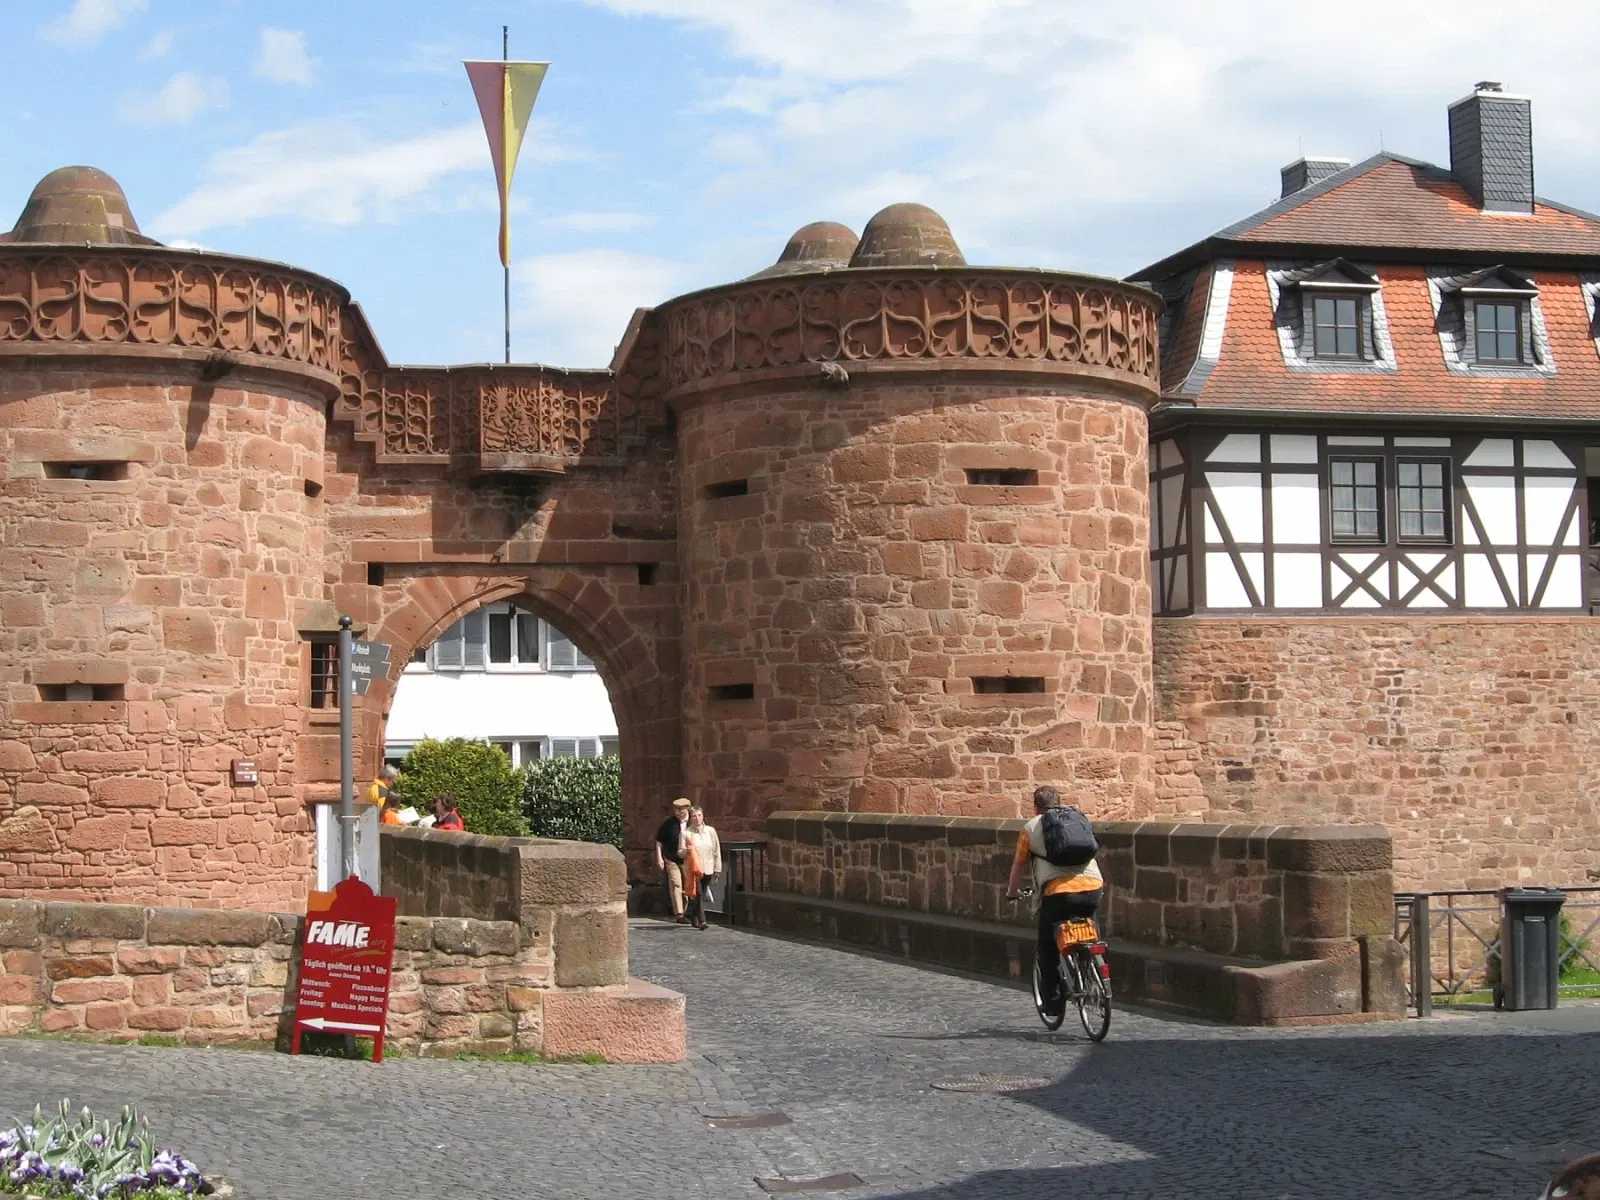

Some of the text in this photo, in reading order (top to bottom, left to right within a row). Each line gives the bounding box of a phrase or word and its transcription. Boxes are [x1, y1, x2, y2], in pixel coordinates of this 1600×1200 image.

[307, 921, 370, 948] FAME
[304, 959, 326, 968] Täglich
[327, 962, 352, 971] geöffnet
[376, 966, 387, 974] Uhr
[301, 979, 331, 988] Mittwoch:
[301, 989, 384, 1003] Freitag: Happy Hour
[300, 999, 383, 1013] Sonntag: Mexican Specials
